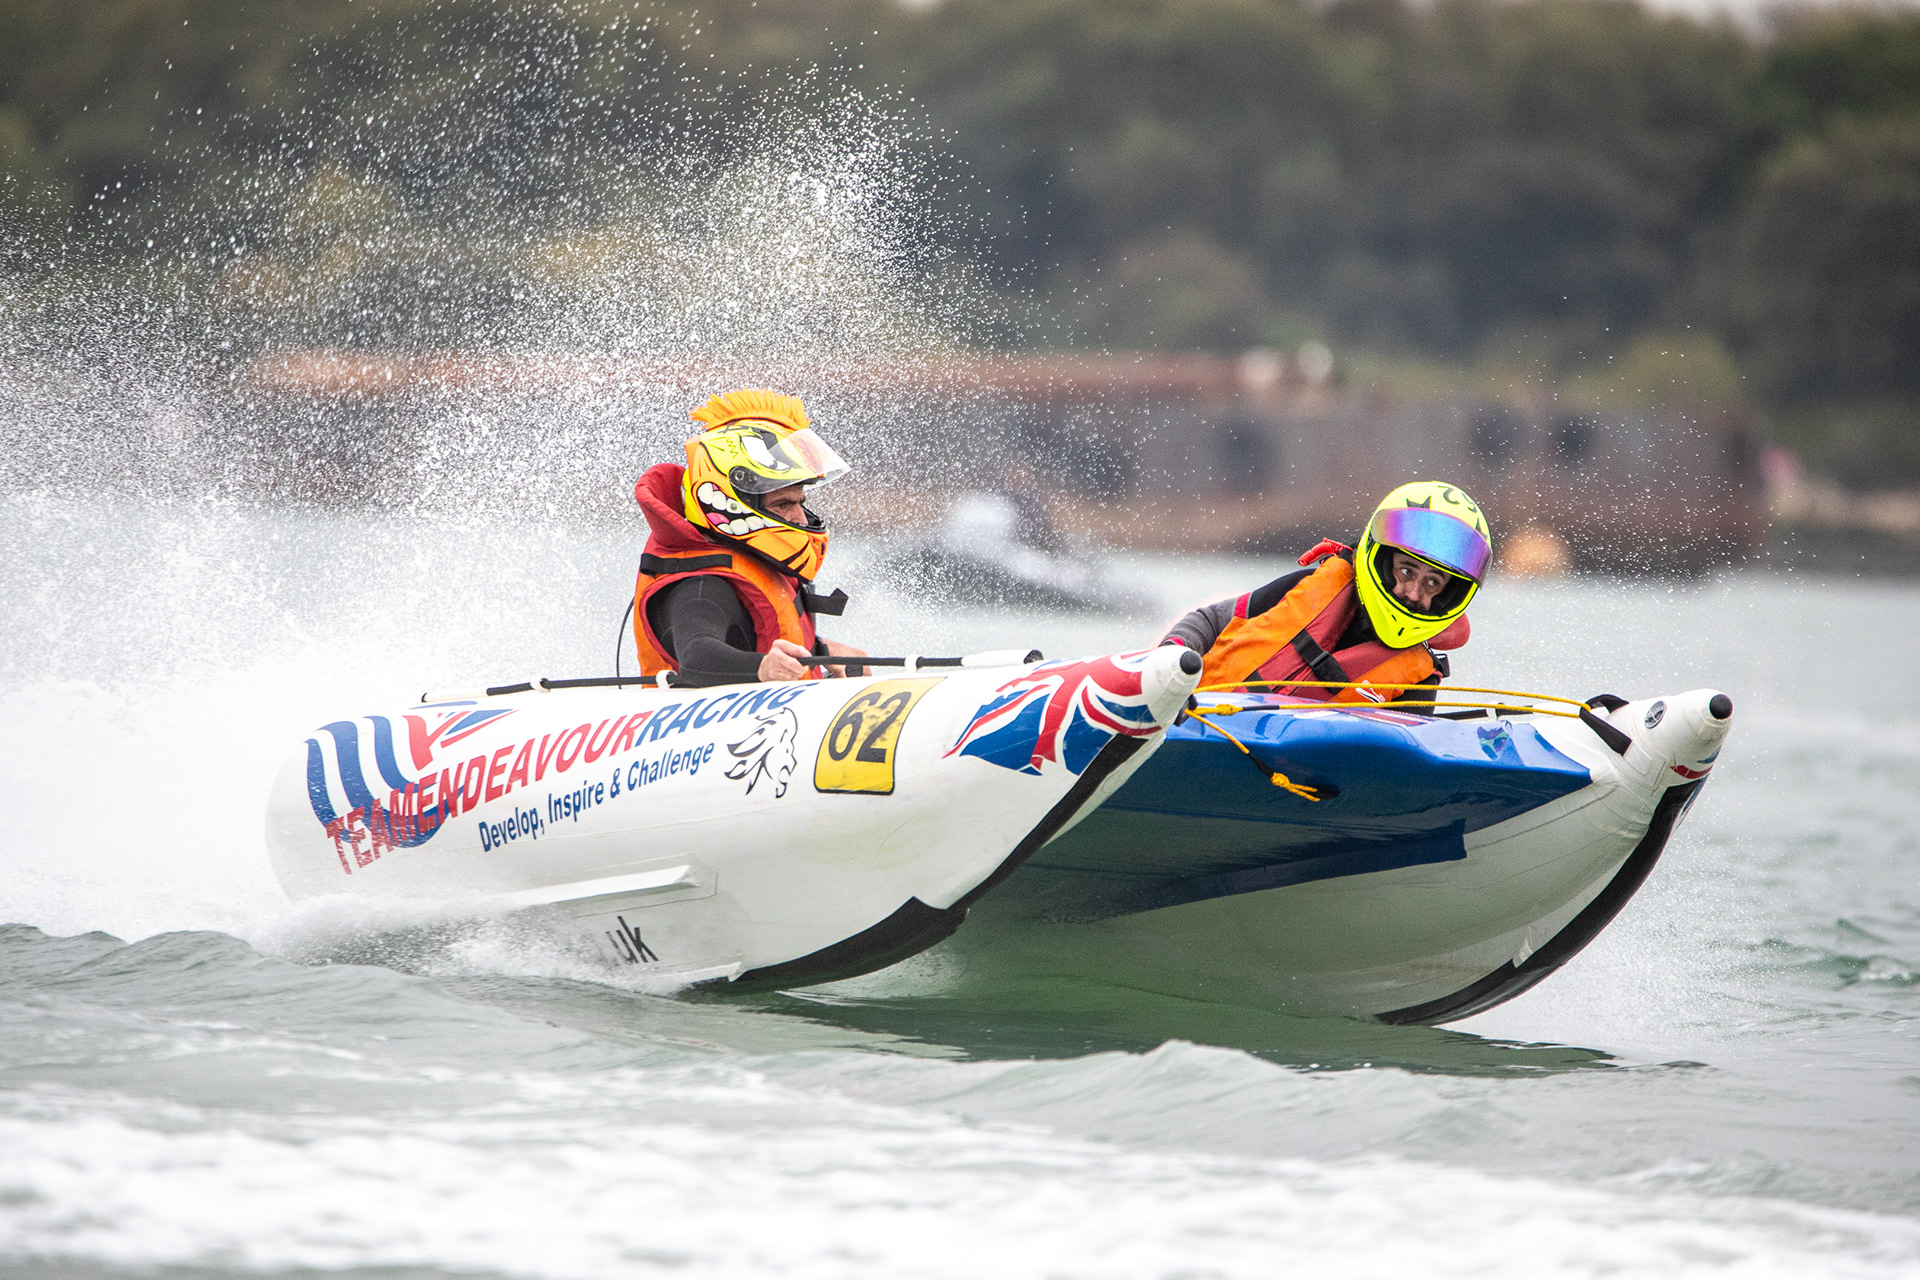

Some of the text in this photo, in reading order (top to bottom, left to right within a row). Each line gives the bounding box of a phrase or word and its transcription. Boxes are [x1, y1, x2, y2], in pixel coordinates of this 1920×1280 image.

[828, 691, 912, 763] 62
[478, 742, 715, 853] Develop, Inspire & Challenge
